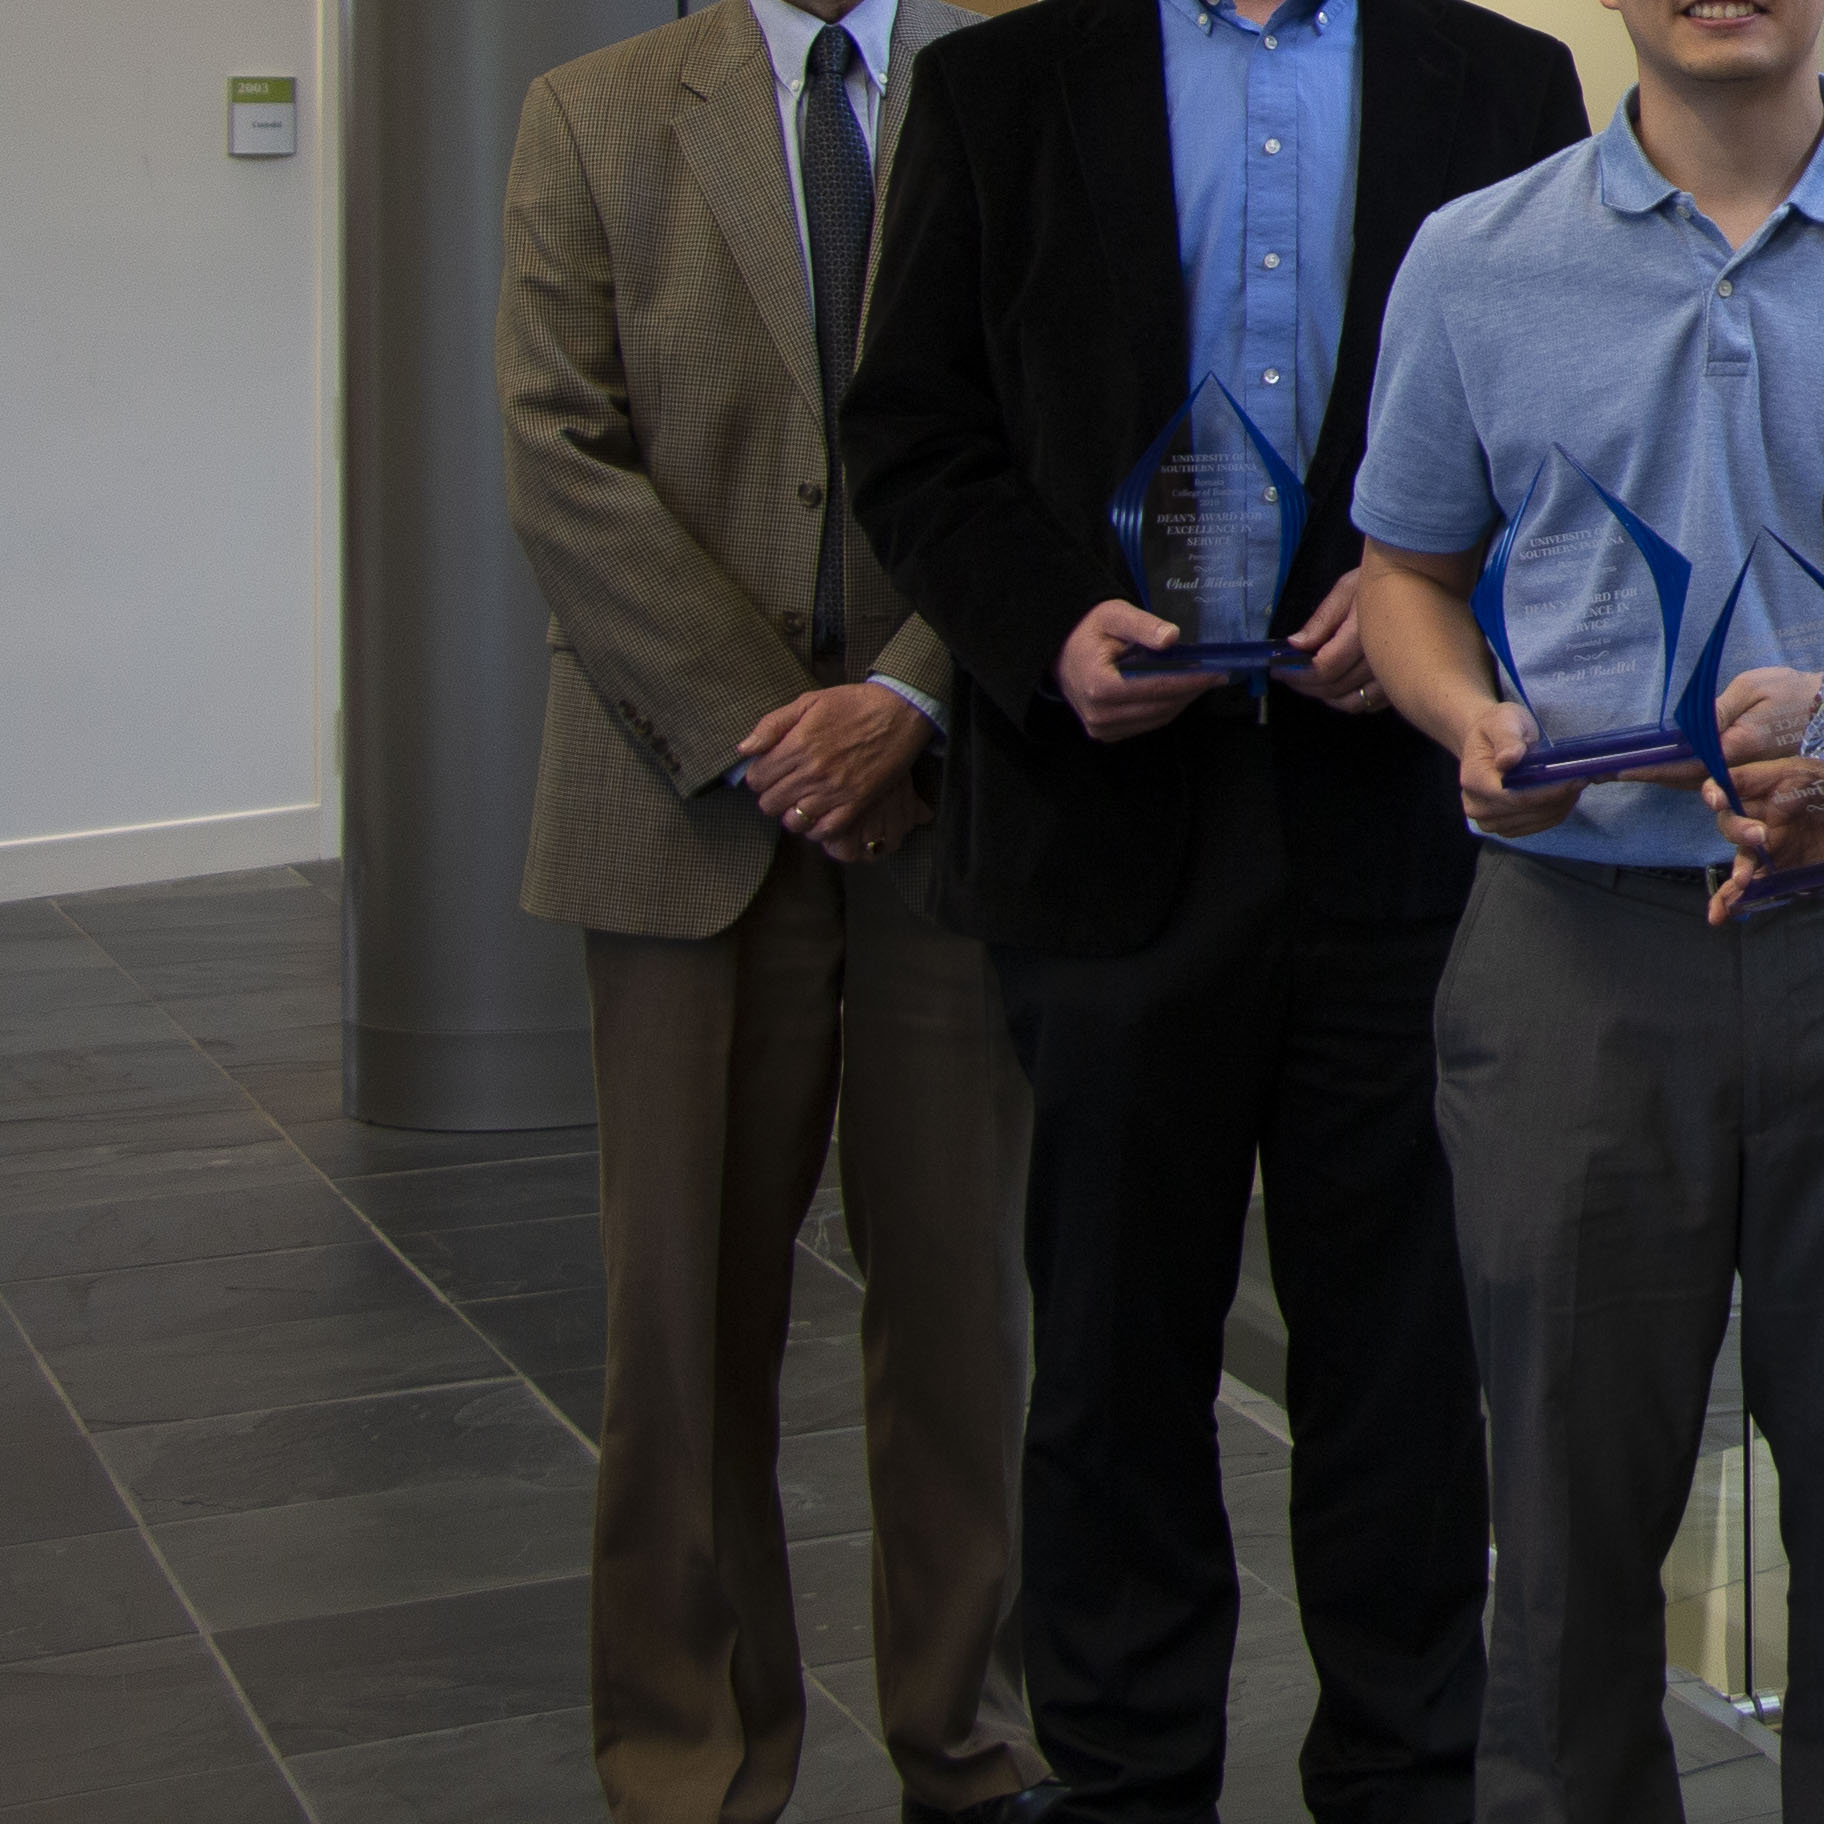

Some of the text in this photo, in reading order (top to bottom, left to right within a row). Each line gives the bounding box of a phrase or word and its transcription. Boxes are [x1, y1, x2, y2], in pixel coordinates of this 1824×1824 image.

[1172, 453, 1230, 463] UNIVERSITY
[1160, 463, 1215, 473] SOUTHERN
[1157, 513, 1196, 524] DEAN'S
[1198, 512, 1238, 522] AWARD
[1166, 524, 1239, 535] EXCELLENCE
[1530, 529, 1592, 547] UNIVERSITY
[1519, 543, 1578, 560] SOUTHERN
